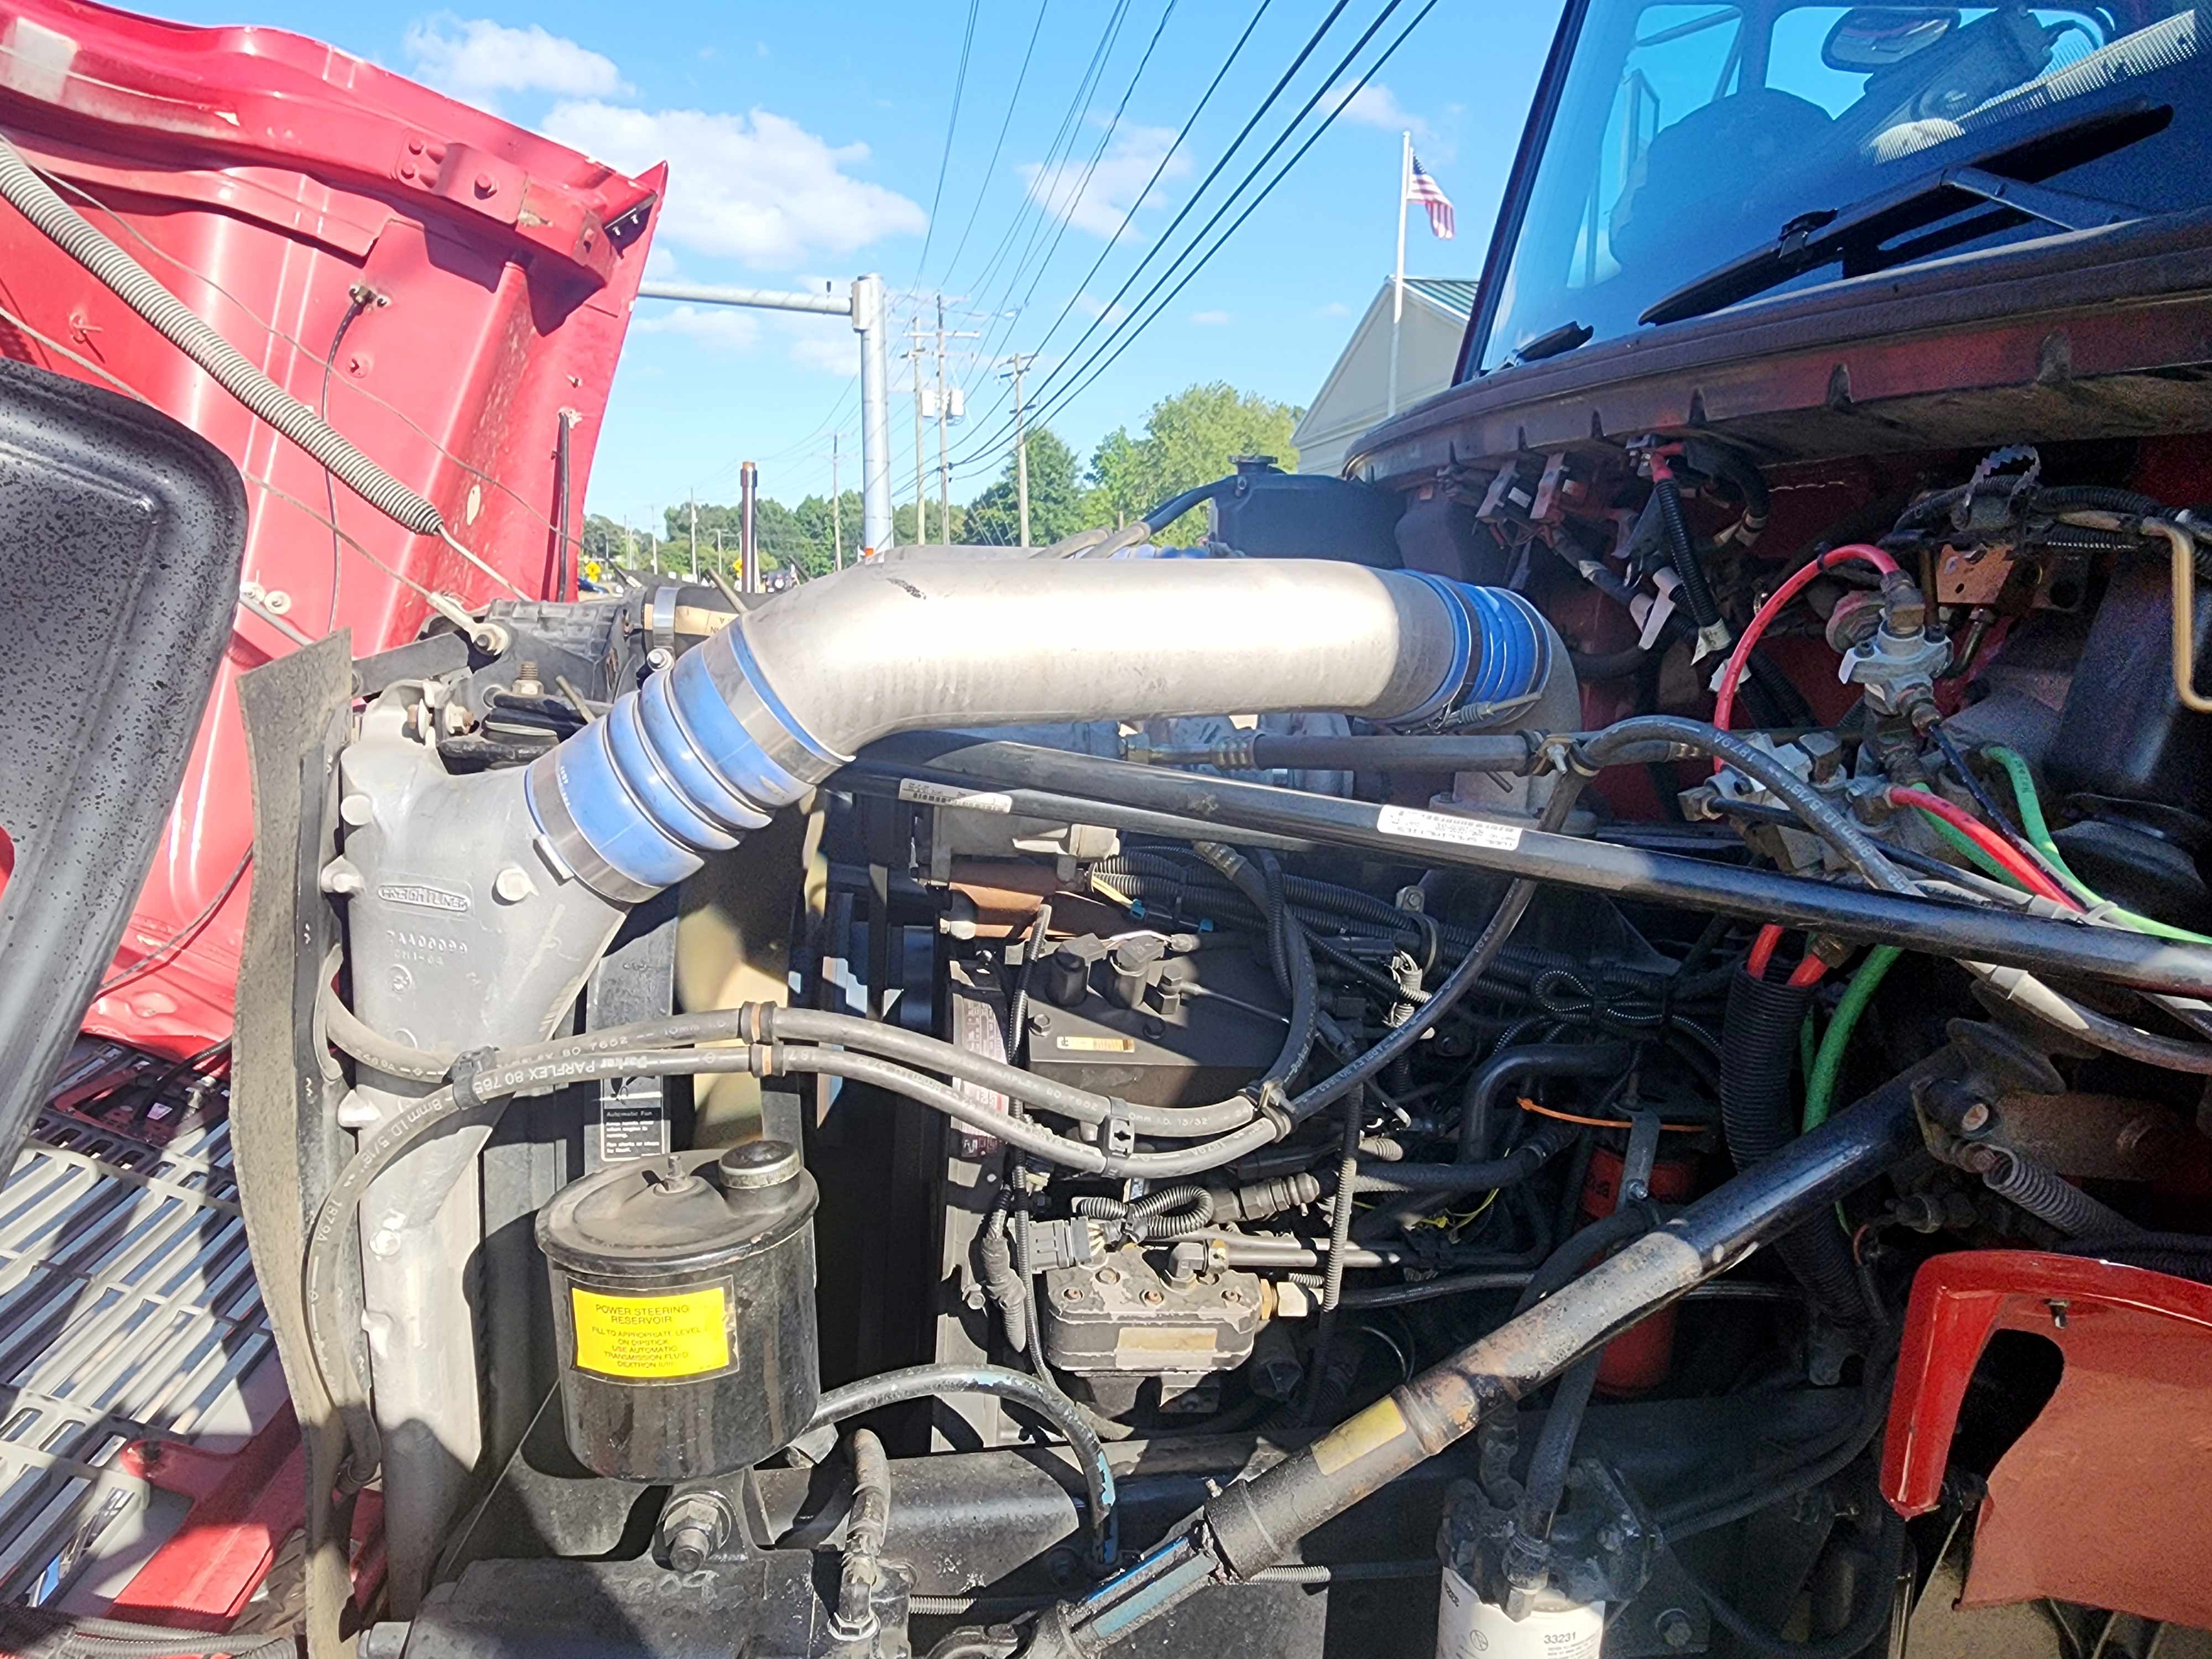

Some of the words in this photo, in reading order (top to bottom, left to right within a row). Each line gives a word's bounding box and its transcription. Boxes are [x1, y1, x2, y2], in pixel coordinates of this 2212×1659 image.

[1713, 731, 1756, 762] 1879A
[1841, 827, 1874, 858] 8mm
[382, 888, 468, 908] FREIGHTLINER
[788, 1050, 815, 1061] 187
[600, 1056, 648, 1070] Parker
[529, 1060, 596, 1082] PARFLEX
[504, 1071, 525, 1085] 80
[406, 1098, 443, 1123] 8mm
[1128, 1112, 1152, 1123] 0mm
[315, 1200, 343, 1243] 1879A
[596, 1303, 631, 1316] POWER
[634, 1304, 690, 1316] STEERING
[611, 1315, 672, 1325] RESERVOIR
[592, 1326, 606, 1335] FILL
[618, 1330, 673, 1338] APPROPRIATE
[675, 1327, 701, 1336] LEVEL
[604, 1350, 662, 1360] TRANSMISSION
[664, 1351, 689, 1360] FLUID
[629, 1345, 677, 1354] AUTOMATIC
[617, 1360, 656, 1369] DEXTRON
[1543, 1631, 1577, 1644] 33231
